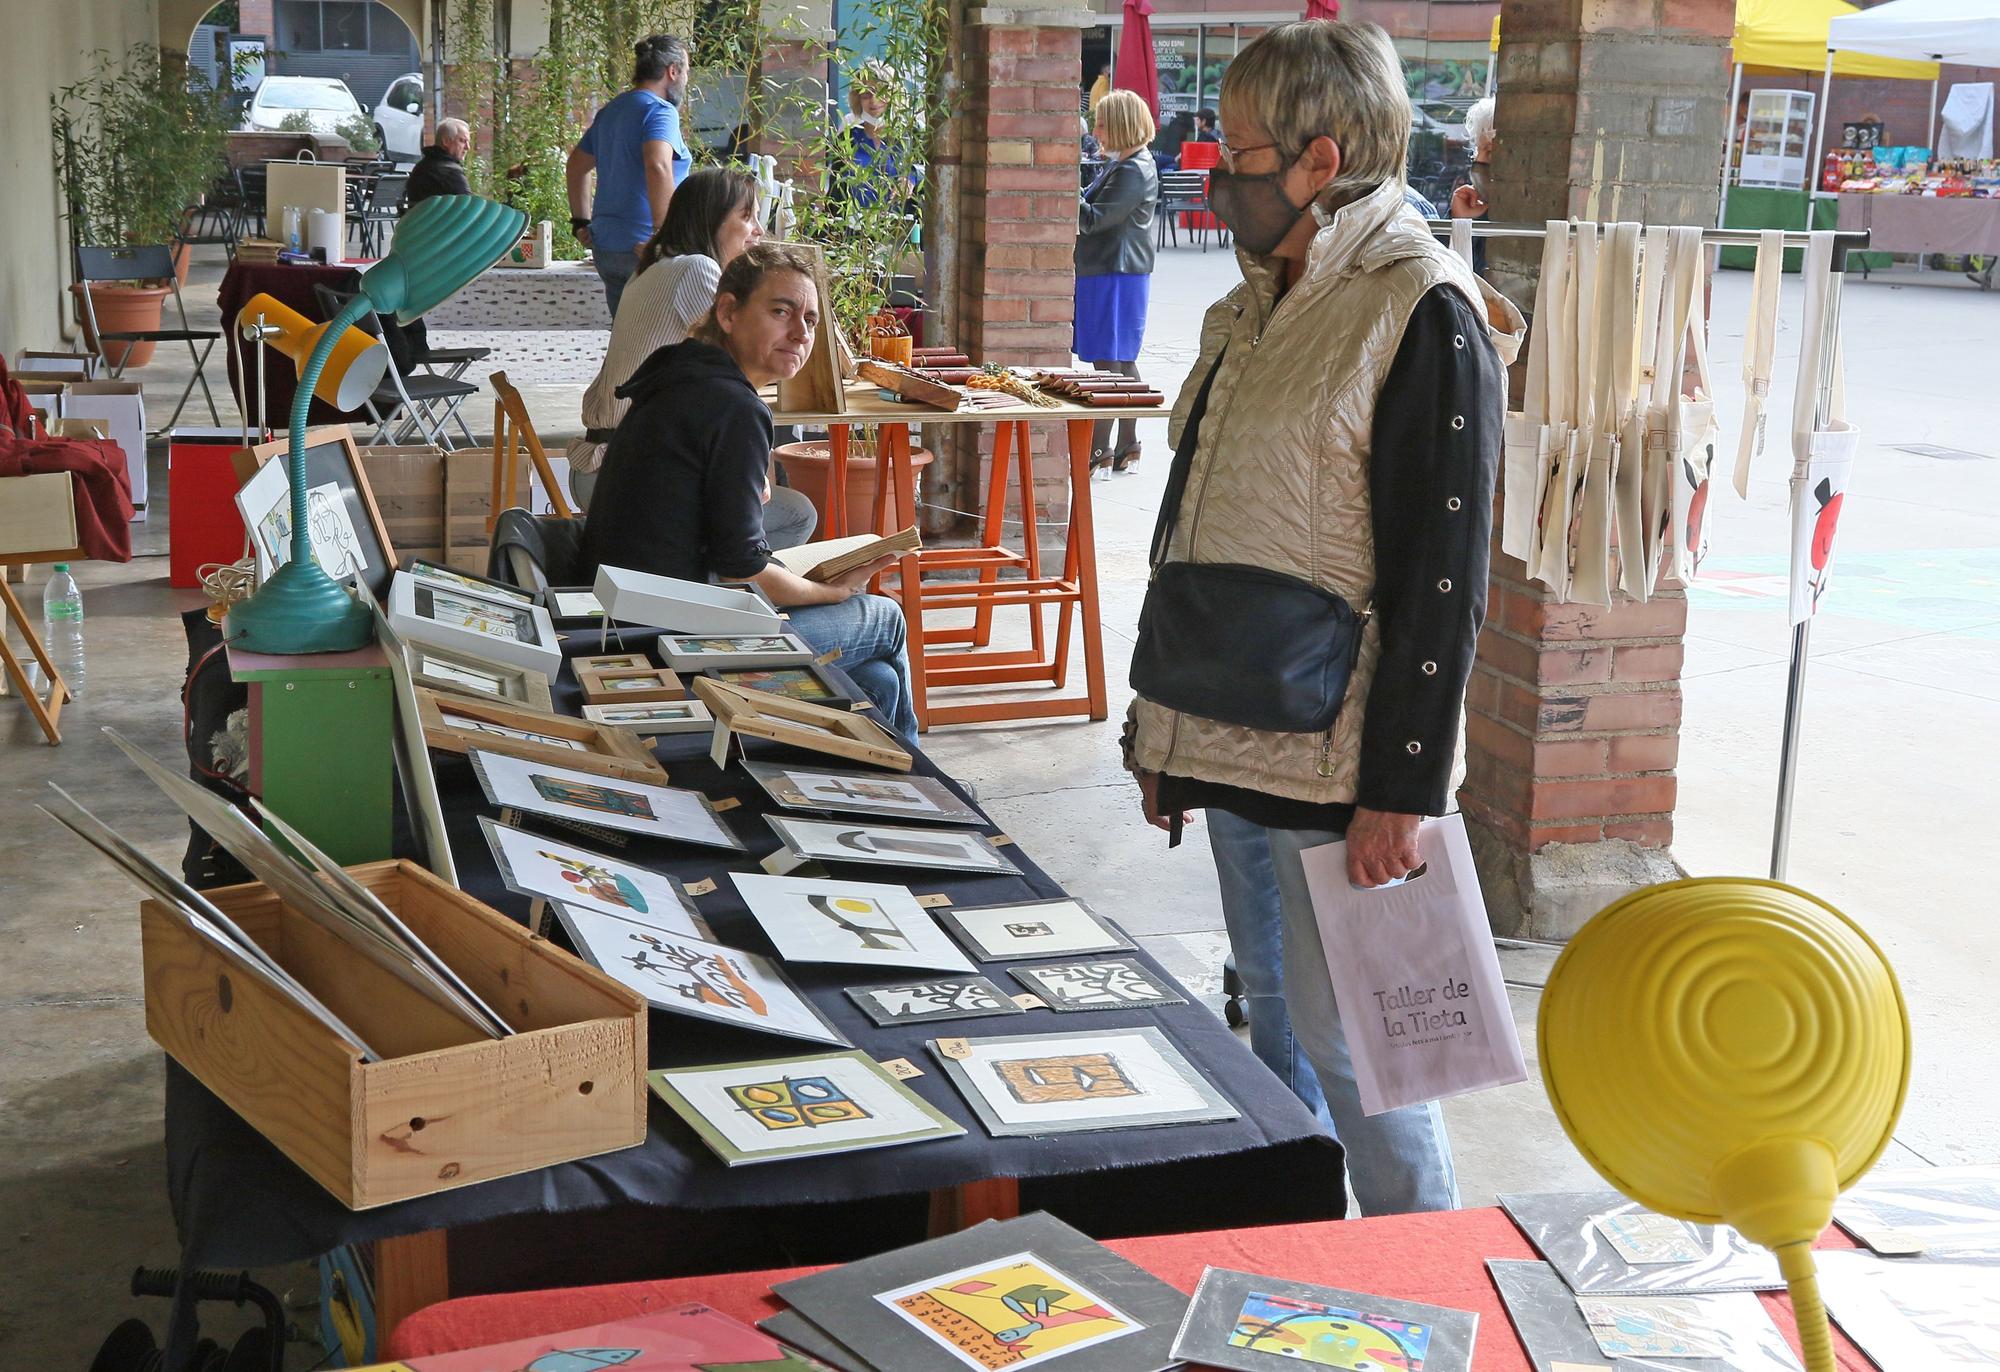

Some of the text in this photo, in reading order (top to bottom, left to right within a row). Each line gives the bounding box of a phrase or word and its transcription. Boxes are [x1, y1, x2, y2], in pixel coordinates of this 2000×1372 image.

[1373, 977, 1470, 1012] Taller de
[1383, 1009, 1467, 1037] la Tieta
